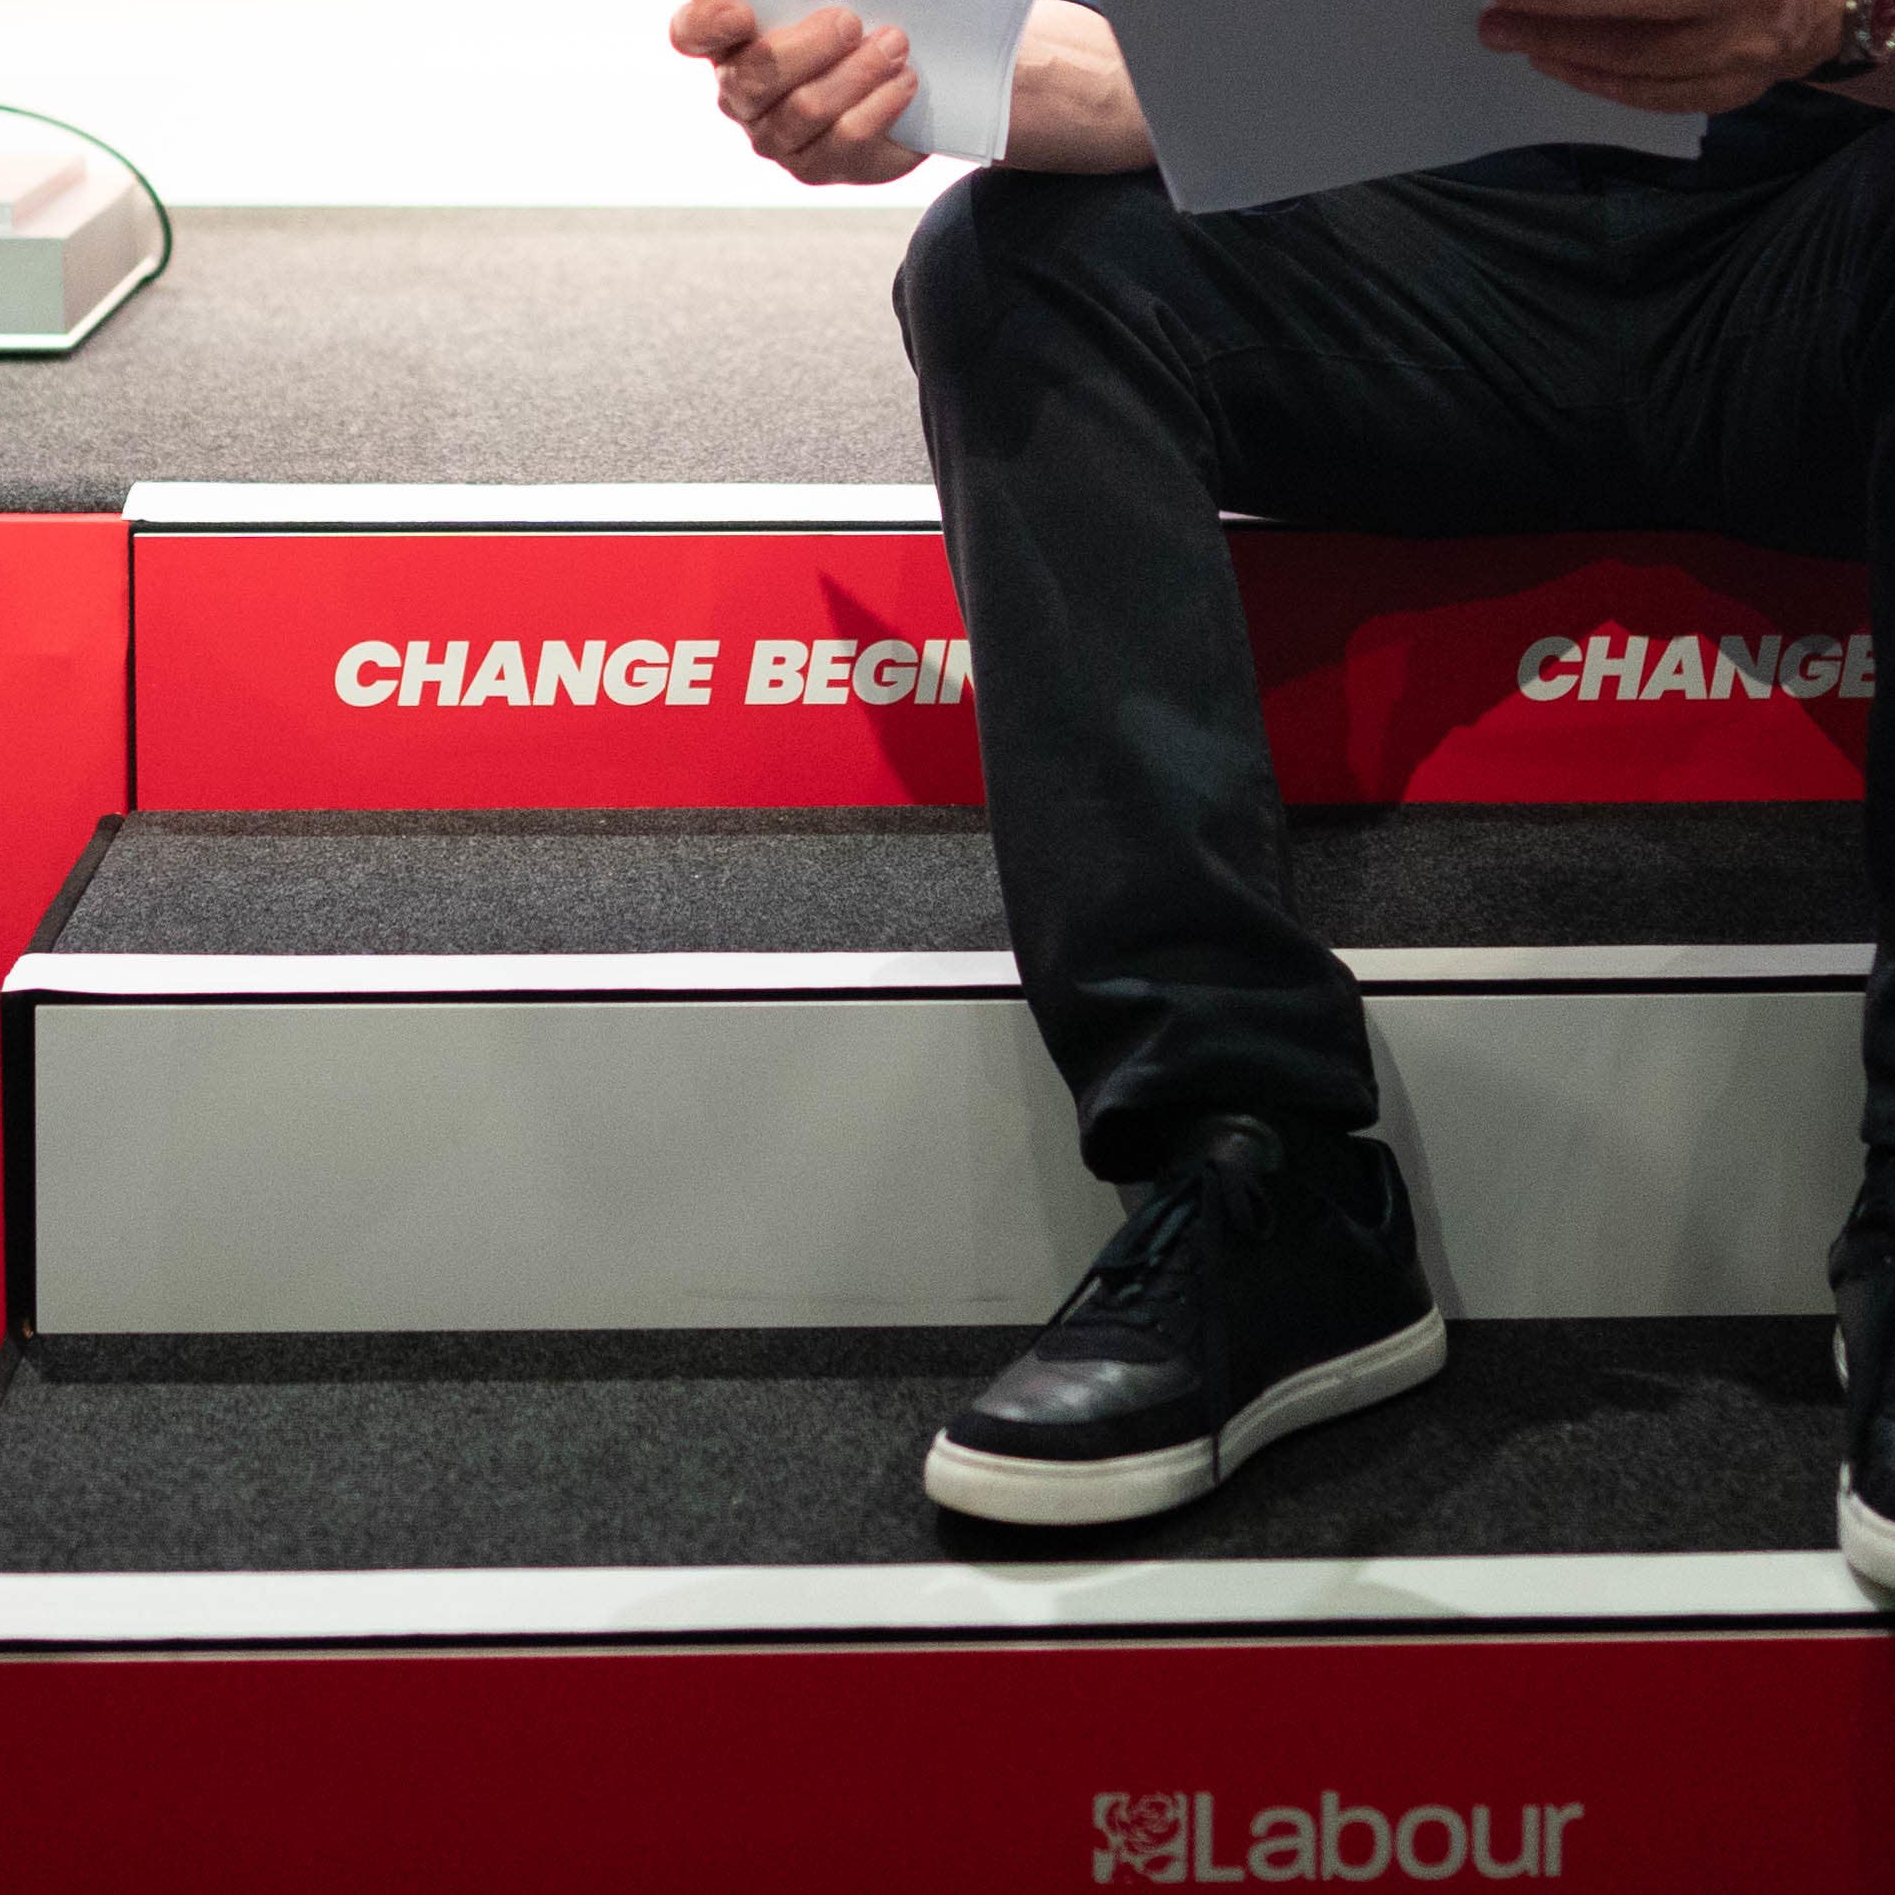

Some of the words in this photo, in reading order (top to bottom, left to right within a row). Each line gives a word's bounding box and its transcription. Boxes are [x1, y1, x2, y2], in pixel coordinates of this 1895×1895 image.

[335, 640, 720, 706] CHANGE
[1518, 634, 1875, 701] CHANGE
[1194, 1790, 1584, 1882] Labour
